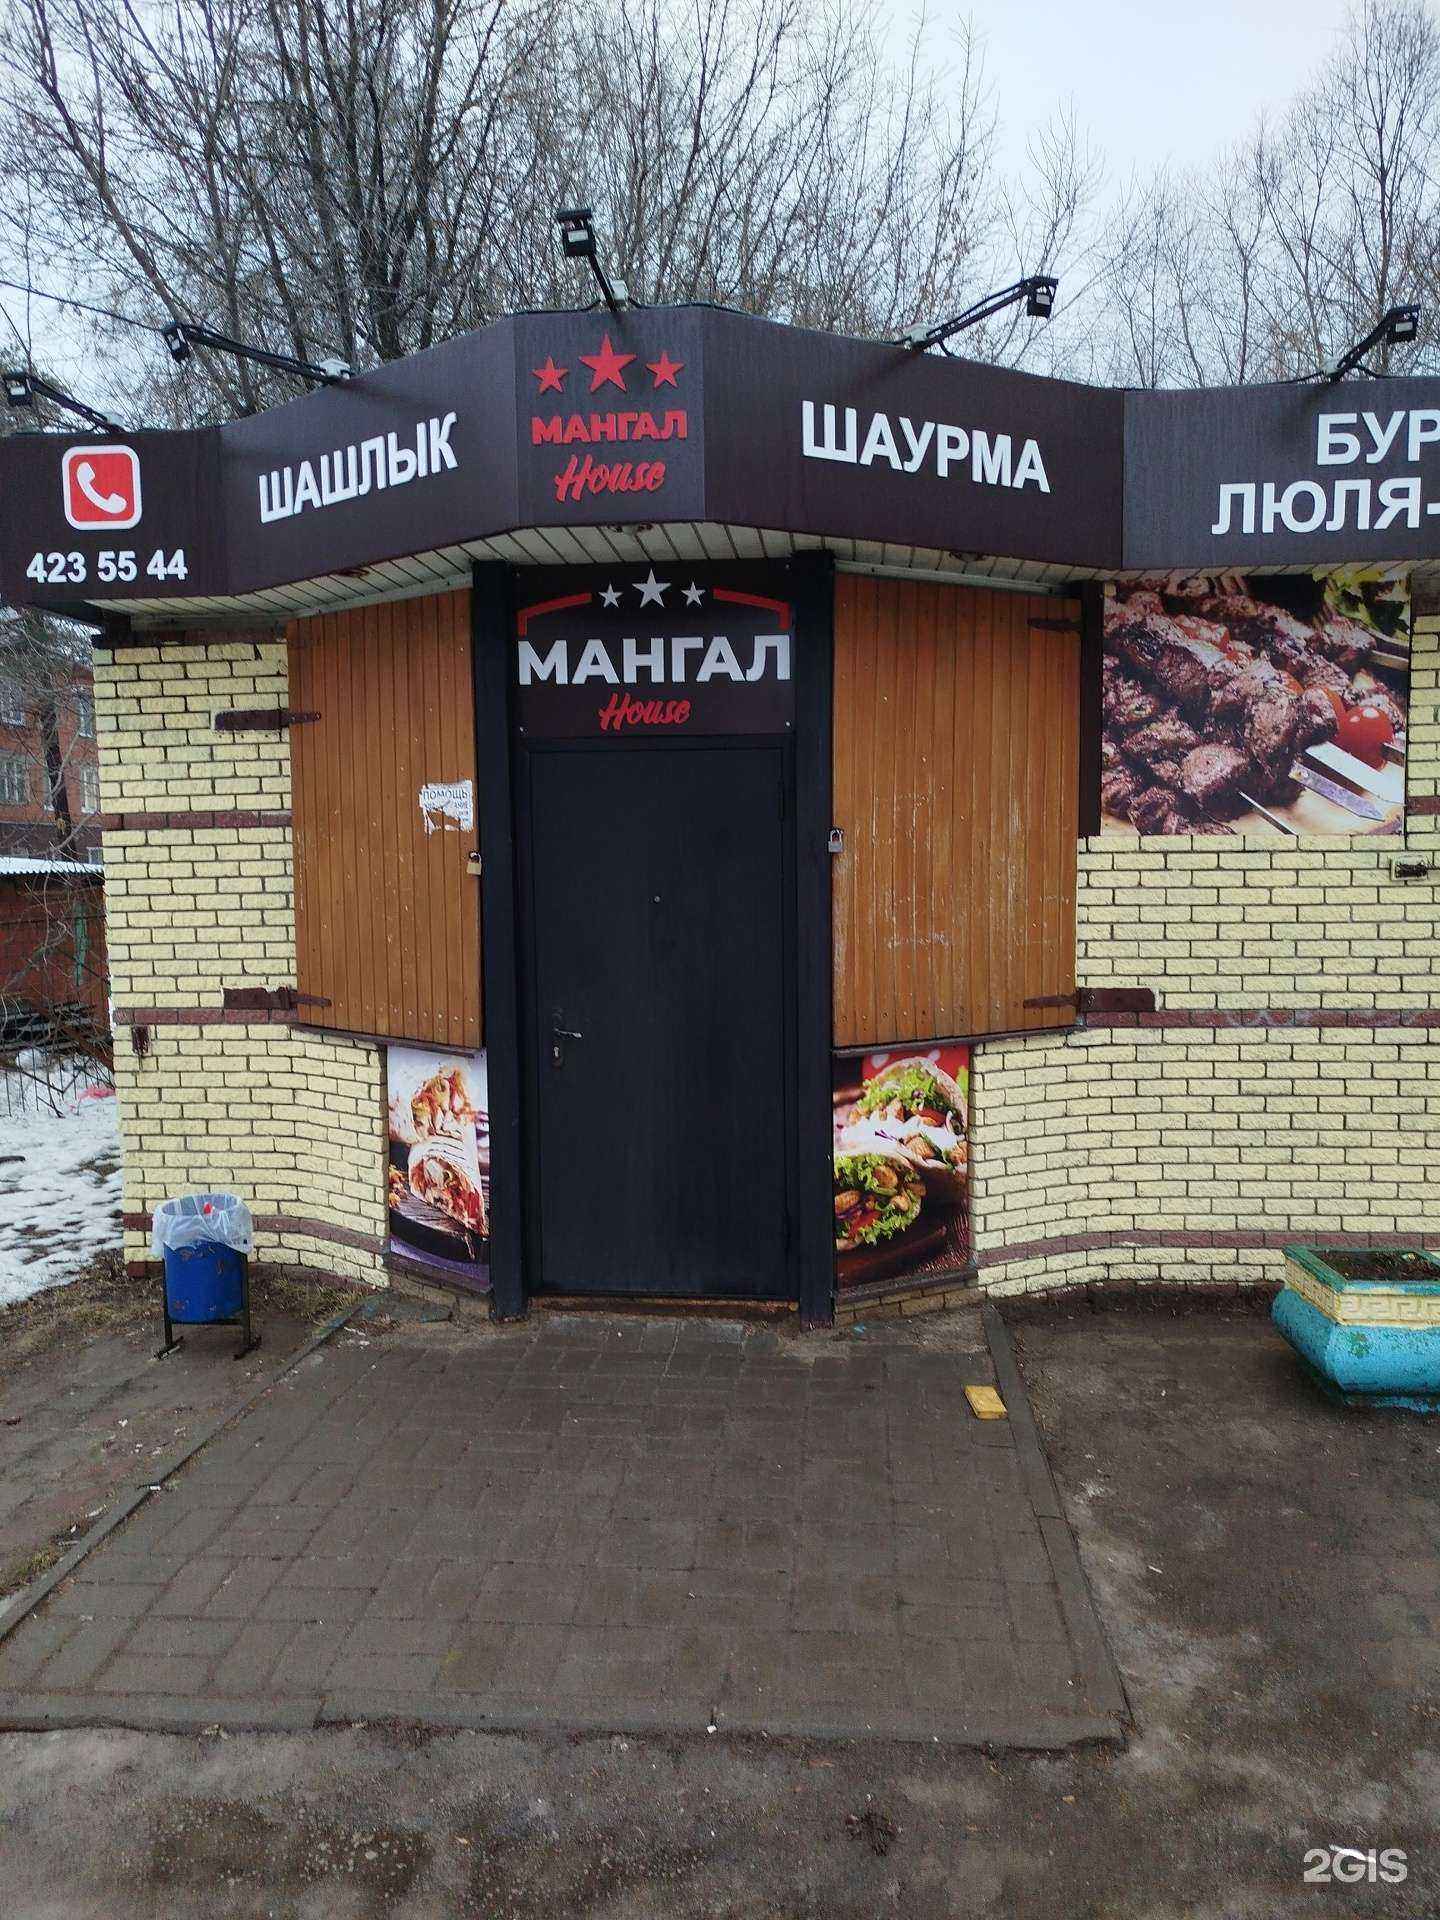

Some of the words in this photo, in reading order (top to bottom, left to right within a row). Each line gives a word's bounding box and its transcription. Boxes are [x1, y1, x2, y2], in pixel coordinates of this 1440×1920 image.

[531, 409, 689, 444] МАНГАЛ
[802, 400, 1051, 494] ШАУРМА
[258, 411, 459, 524] ШАШЛЫК
[554, 454, 666, 502] House
[26, 552, 88, 583] 423
[97, 550, 138, 582] 55
[146, 549, 188, 580] 44
[517, 634, 791, 686] МАНГАЛ
[598, 692, 692, 730] House
